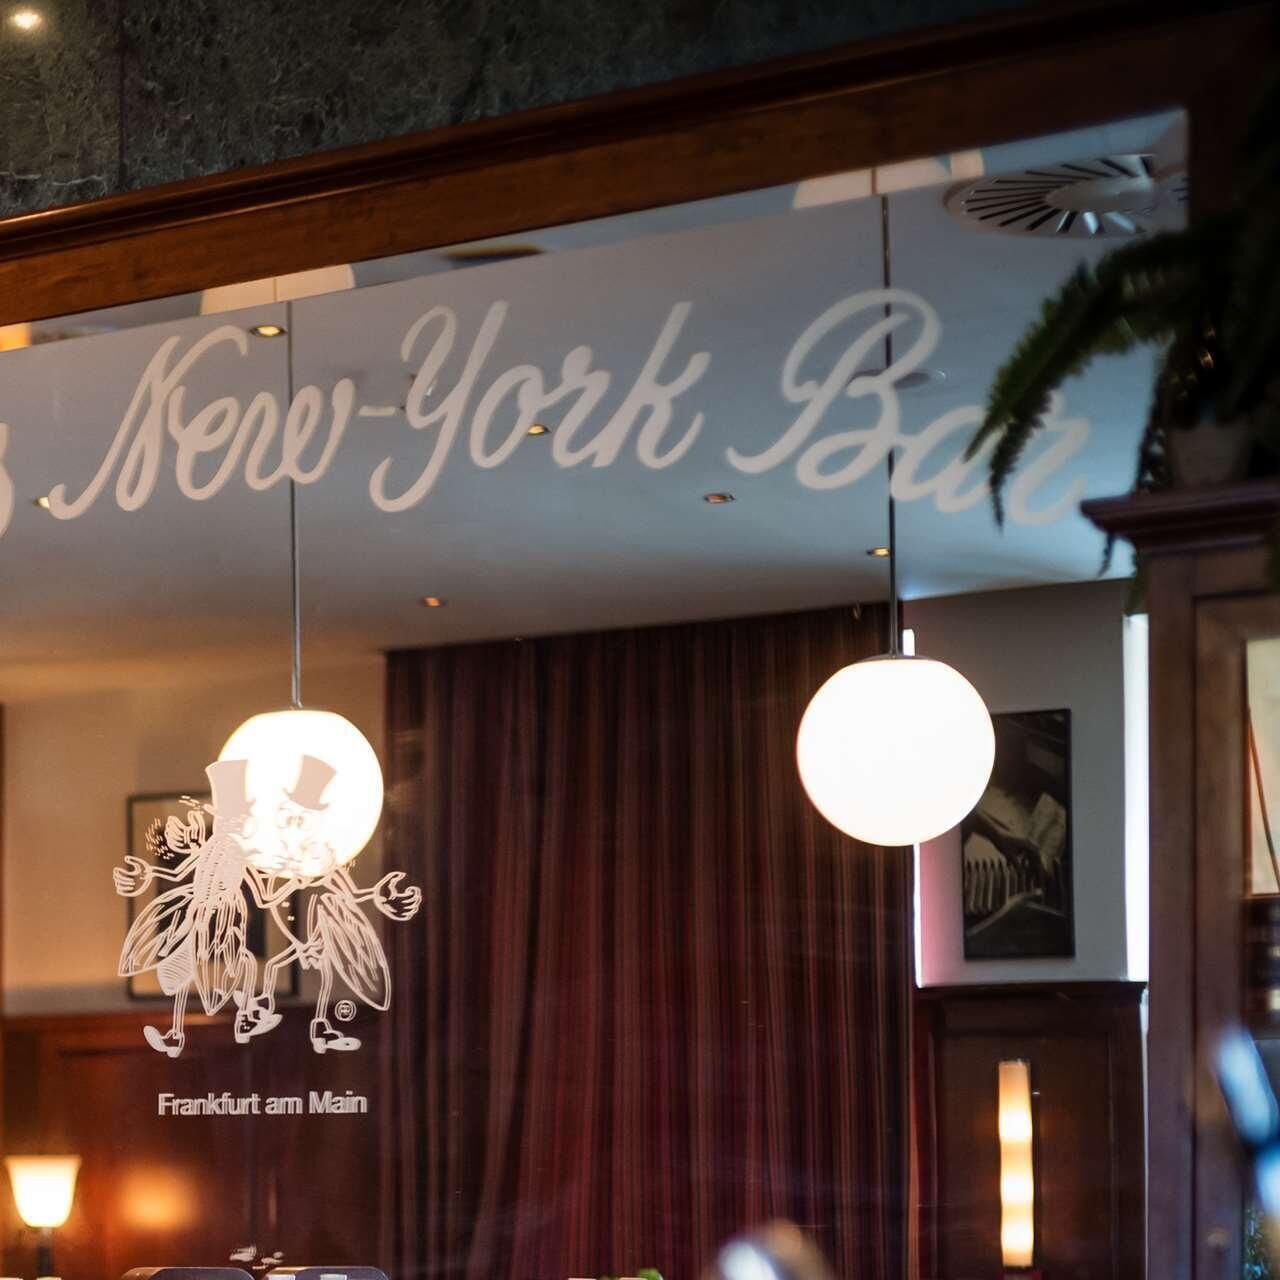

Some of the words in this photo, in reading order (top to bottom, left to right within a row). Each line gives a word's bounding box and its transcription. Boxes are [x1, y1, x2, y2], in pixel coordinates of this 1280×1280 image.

[726, 287, 1092, 525] Bar
[158, 1092, 261, 1116] Frankfurt
[265, 1095, 303, 1115] am
[308, 1090, 368, 1114] Main
